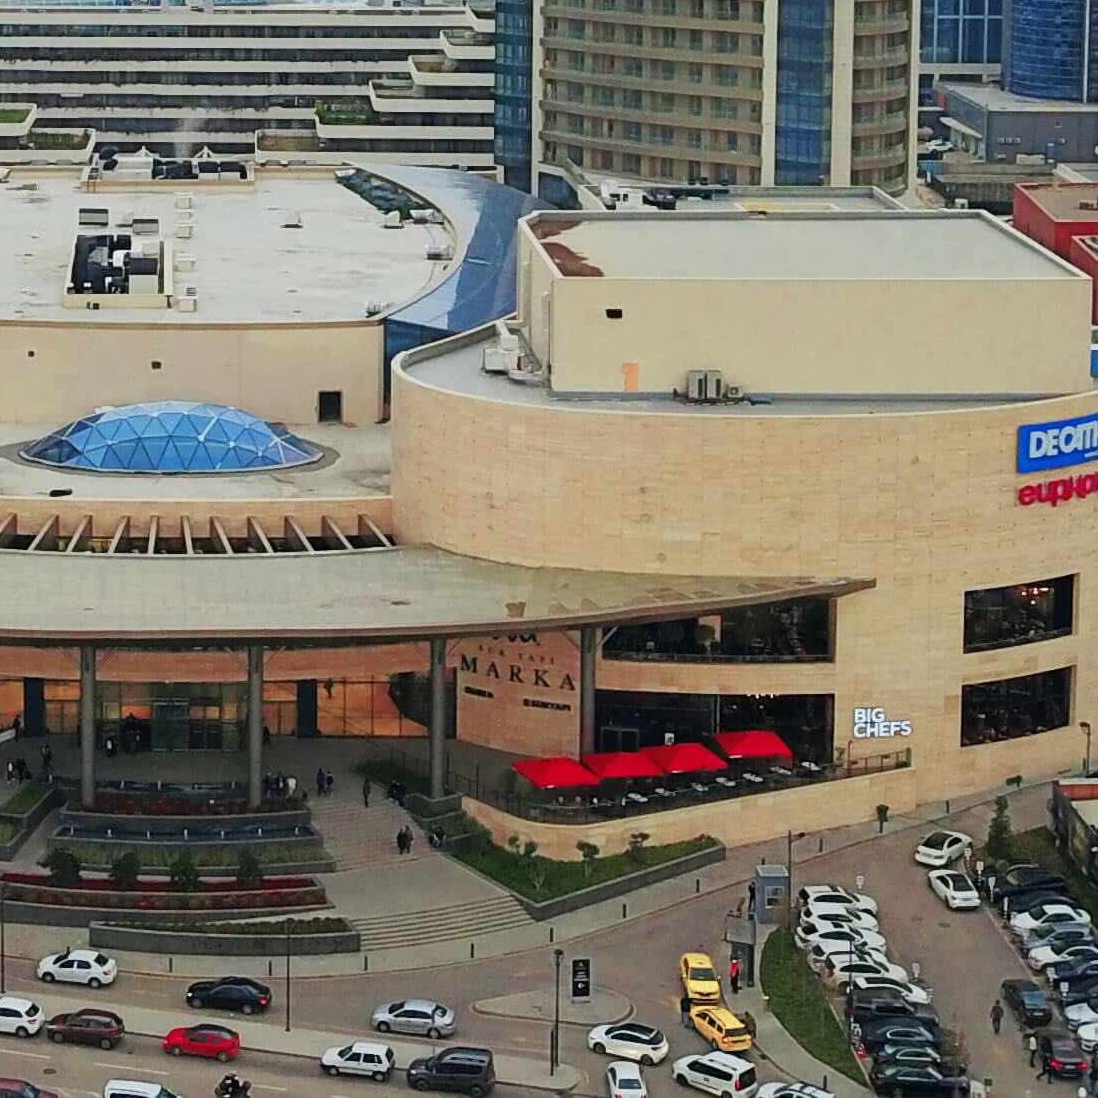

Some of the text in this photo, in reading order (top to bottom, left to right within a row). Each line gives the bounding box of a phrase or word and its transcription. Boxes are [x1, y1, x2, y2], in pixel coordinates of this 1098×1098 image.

[460, 653, 576, 691] MARKA
[854, 708, 885, 723] BIG
[854, 720, 912, 739] CHEFS
